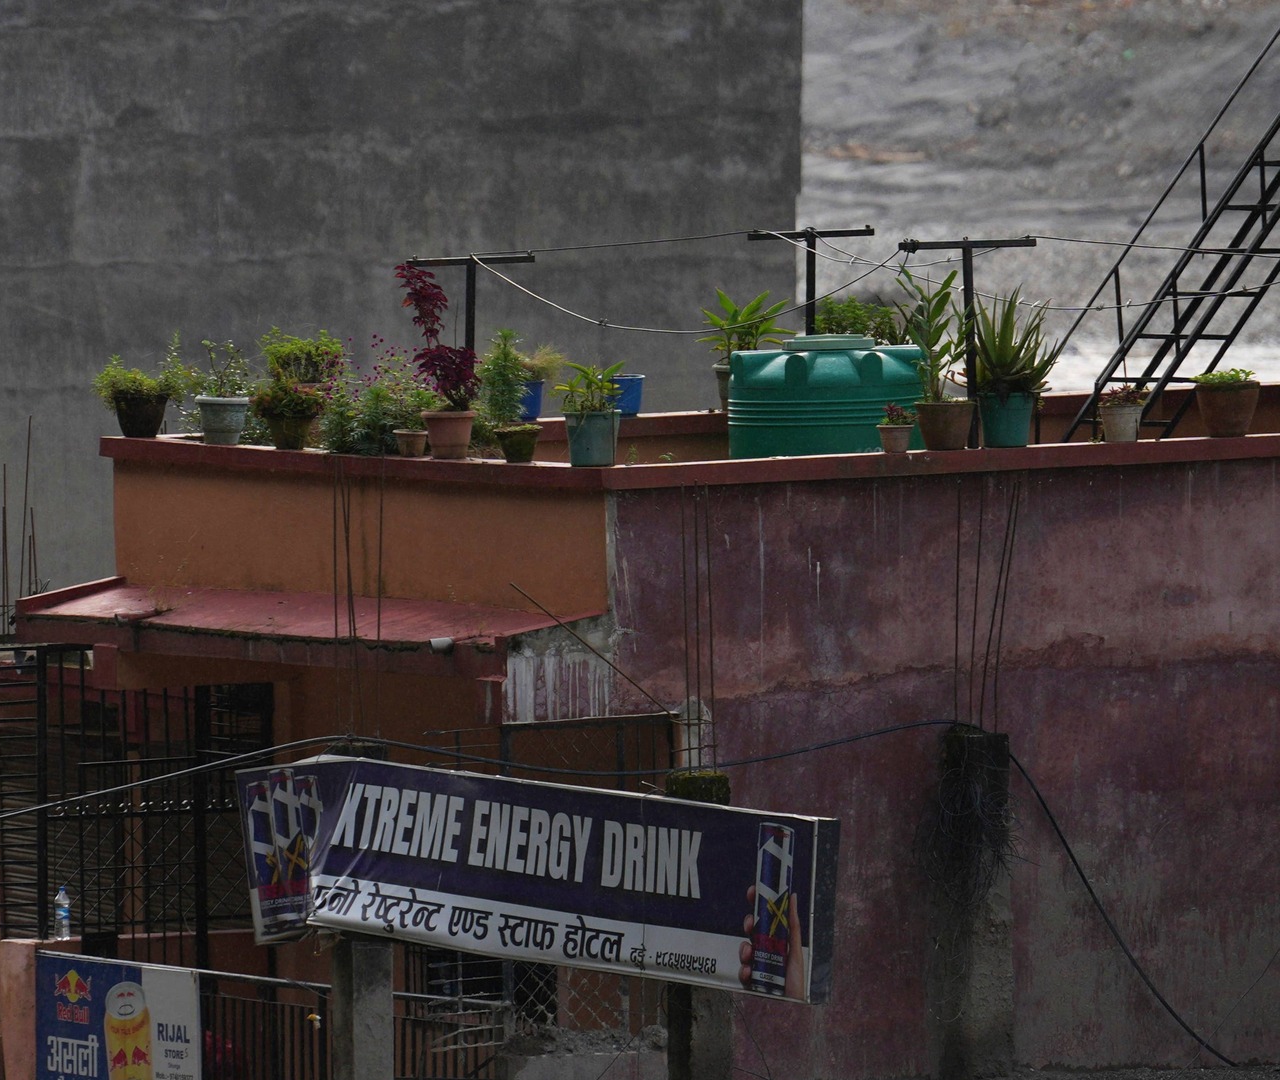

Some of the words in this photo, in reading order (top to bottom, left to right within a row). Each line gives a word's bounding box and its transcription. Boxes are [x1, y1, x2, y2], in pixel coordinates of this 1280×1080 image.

[330, 783, 465, 864] XTREME
[467, 801, 594, 884] ENERGY
[601, 819, 702, 899] DRINK
[448, 905, 493, 941] एण्ड
[498, 913, 559, 951] स्टाफ
[562, 914, 625, 963] होटल
[57, 1001, 72, 1021] Red
[74, 1004, 90, 1025] Bull
[157, 1023, 190, 1044] RIJAL
[46, 1034, 99, 1078] असली
